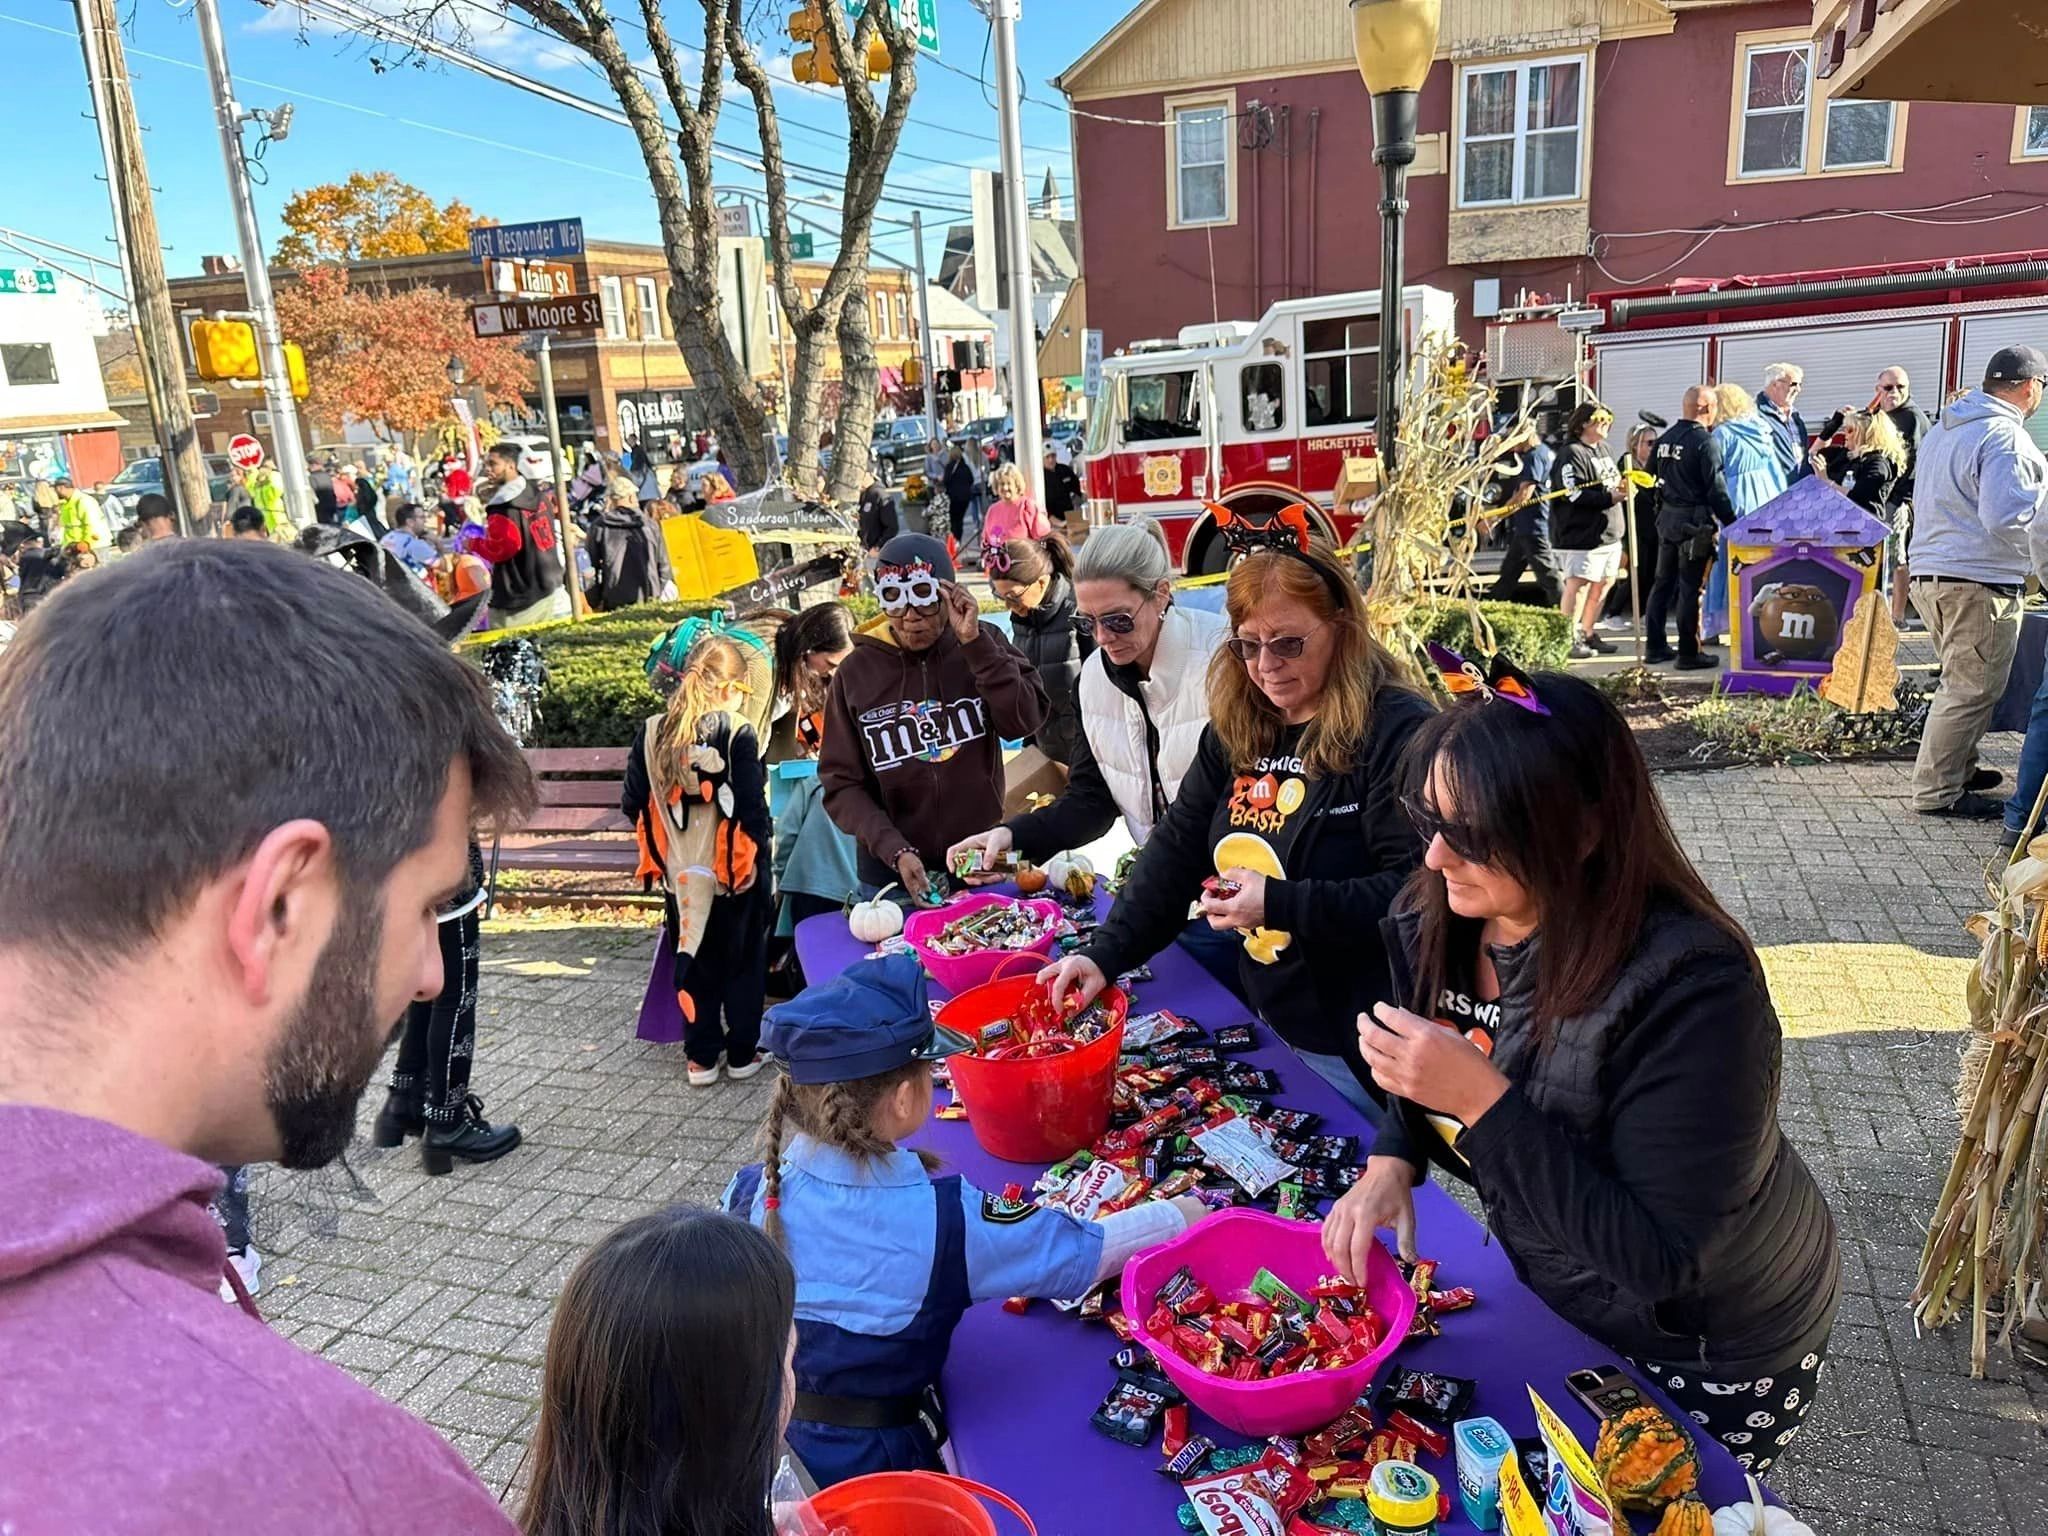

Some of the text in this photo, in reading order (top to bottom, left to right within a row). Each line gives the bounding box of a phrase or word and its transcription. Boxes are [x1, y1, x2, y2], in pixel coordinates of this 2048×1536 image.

[724, 211, 741, 222] NO
[470, 222, 582, 257] First Responder Way
[555, 271, 571, 294] St
[503, 299, 600, 329] W. Moore St
[231, 442, 260, 461] STOP
[1230, 806, 1285, 834] BASH
[1329, 803, 1360, 816] WRIGLEY
[1437, 989, 1472, 1015] RS
[1122, 1384, 1165, 1404] BOO!
[1471, 1428, 1500, 1449] Extra
[1199, 1493, 1249, 1536] bos
[1548, 1470, 1586, 1536] Orbi
